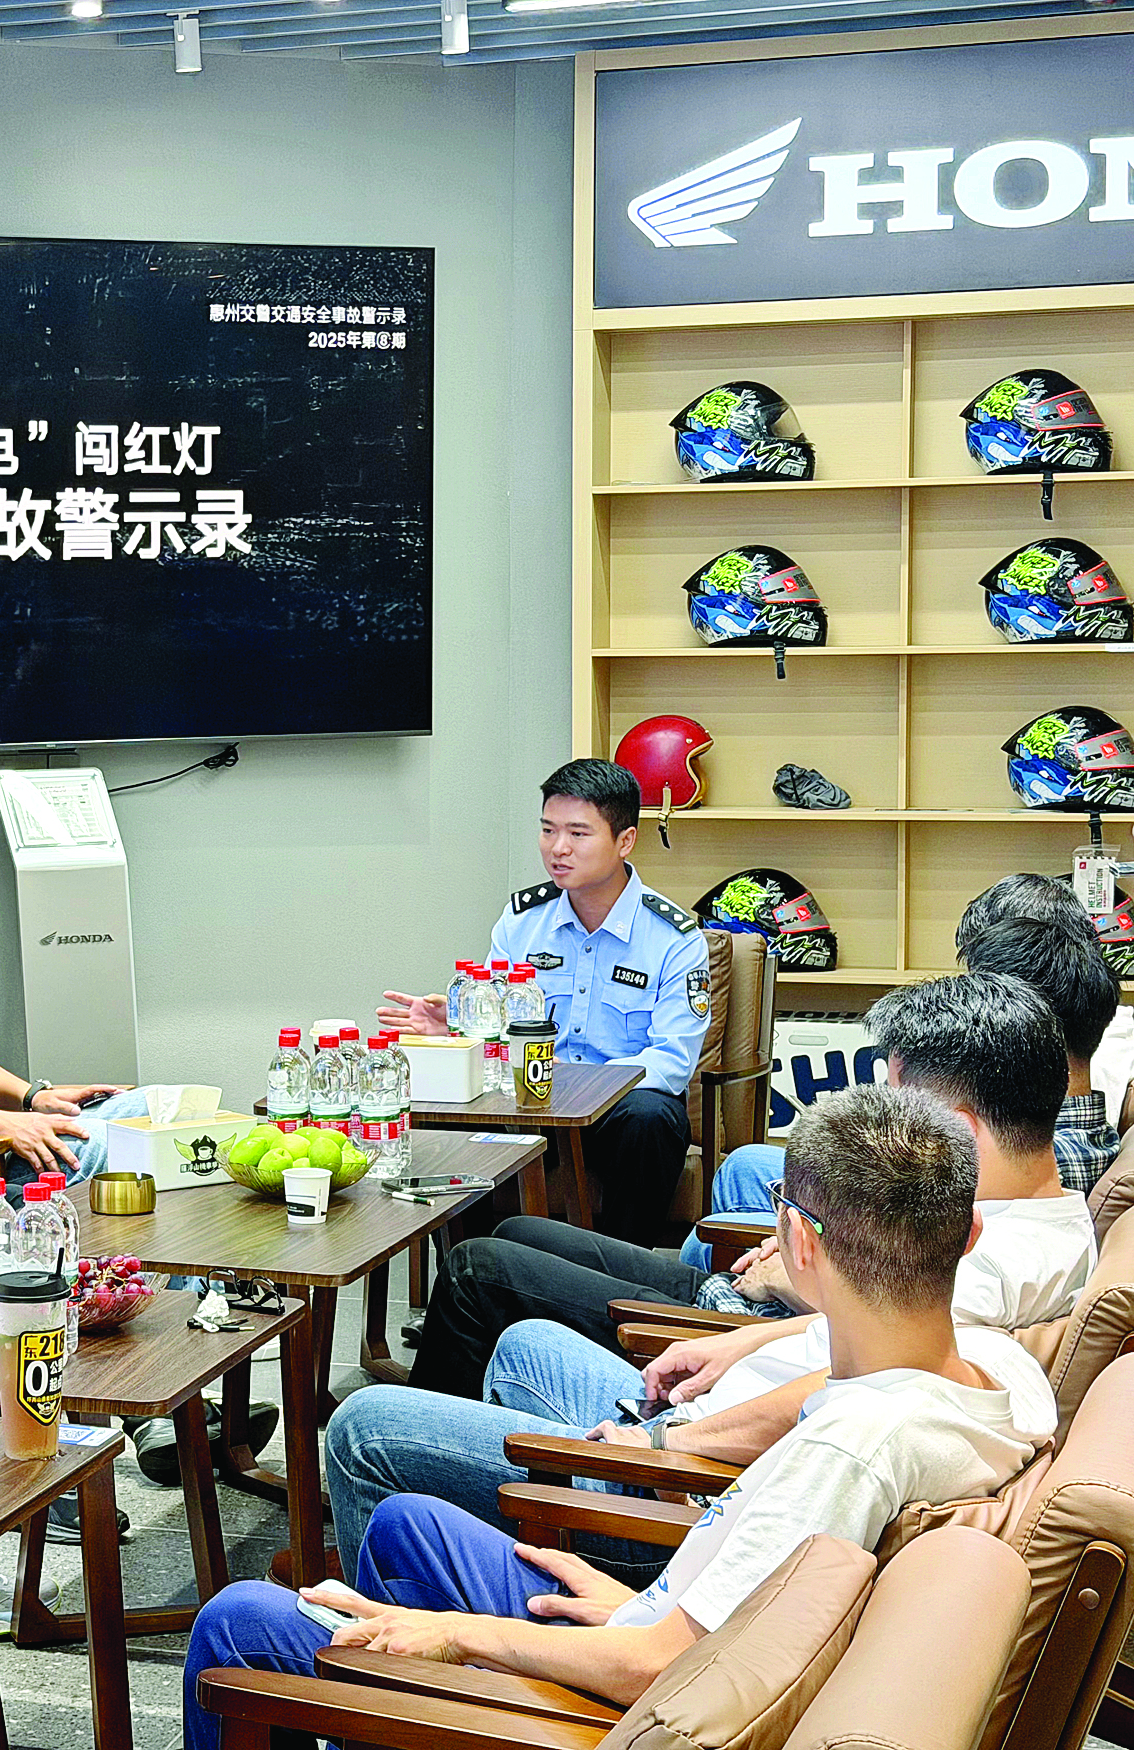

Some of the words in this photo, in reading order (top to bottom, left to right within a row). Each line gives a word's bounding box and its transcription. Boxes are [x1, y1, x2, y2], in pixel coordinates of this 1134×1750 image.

[209, 302, 406, 325] 惠州交警交通安全事故警示录
[1088, 881, 1096, 908] HELMET
[57, 933, 115, 946] HONDA
[614, 968, 646, 986] 135144
[25, 1360, 49, 1397] 0
